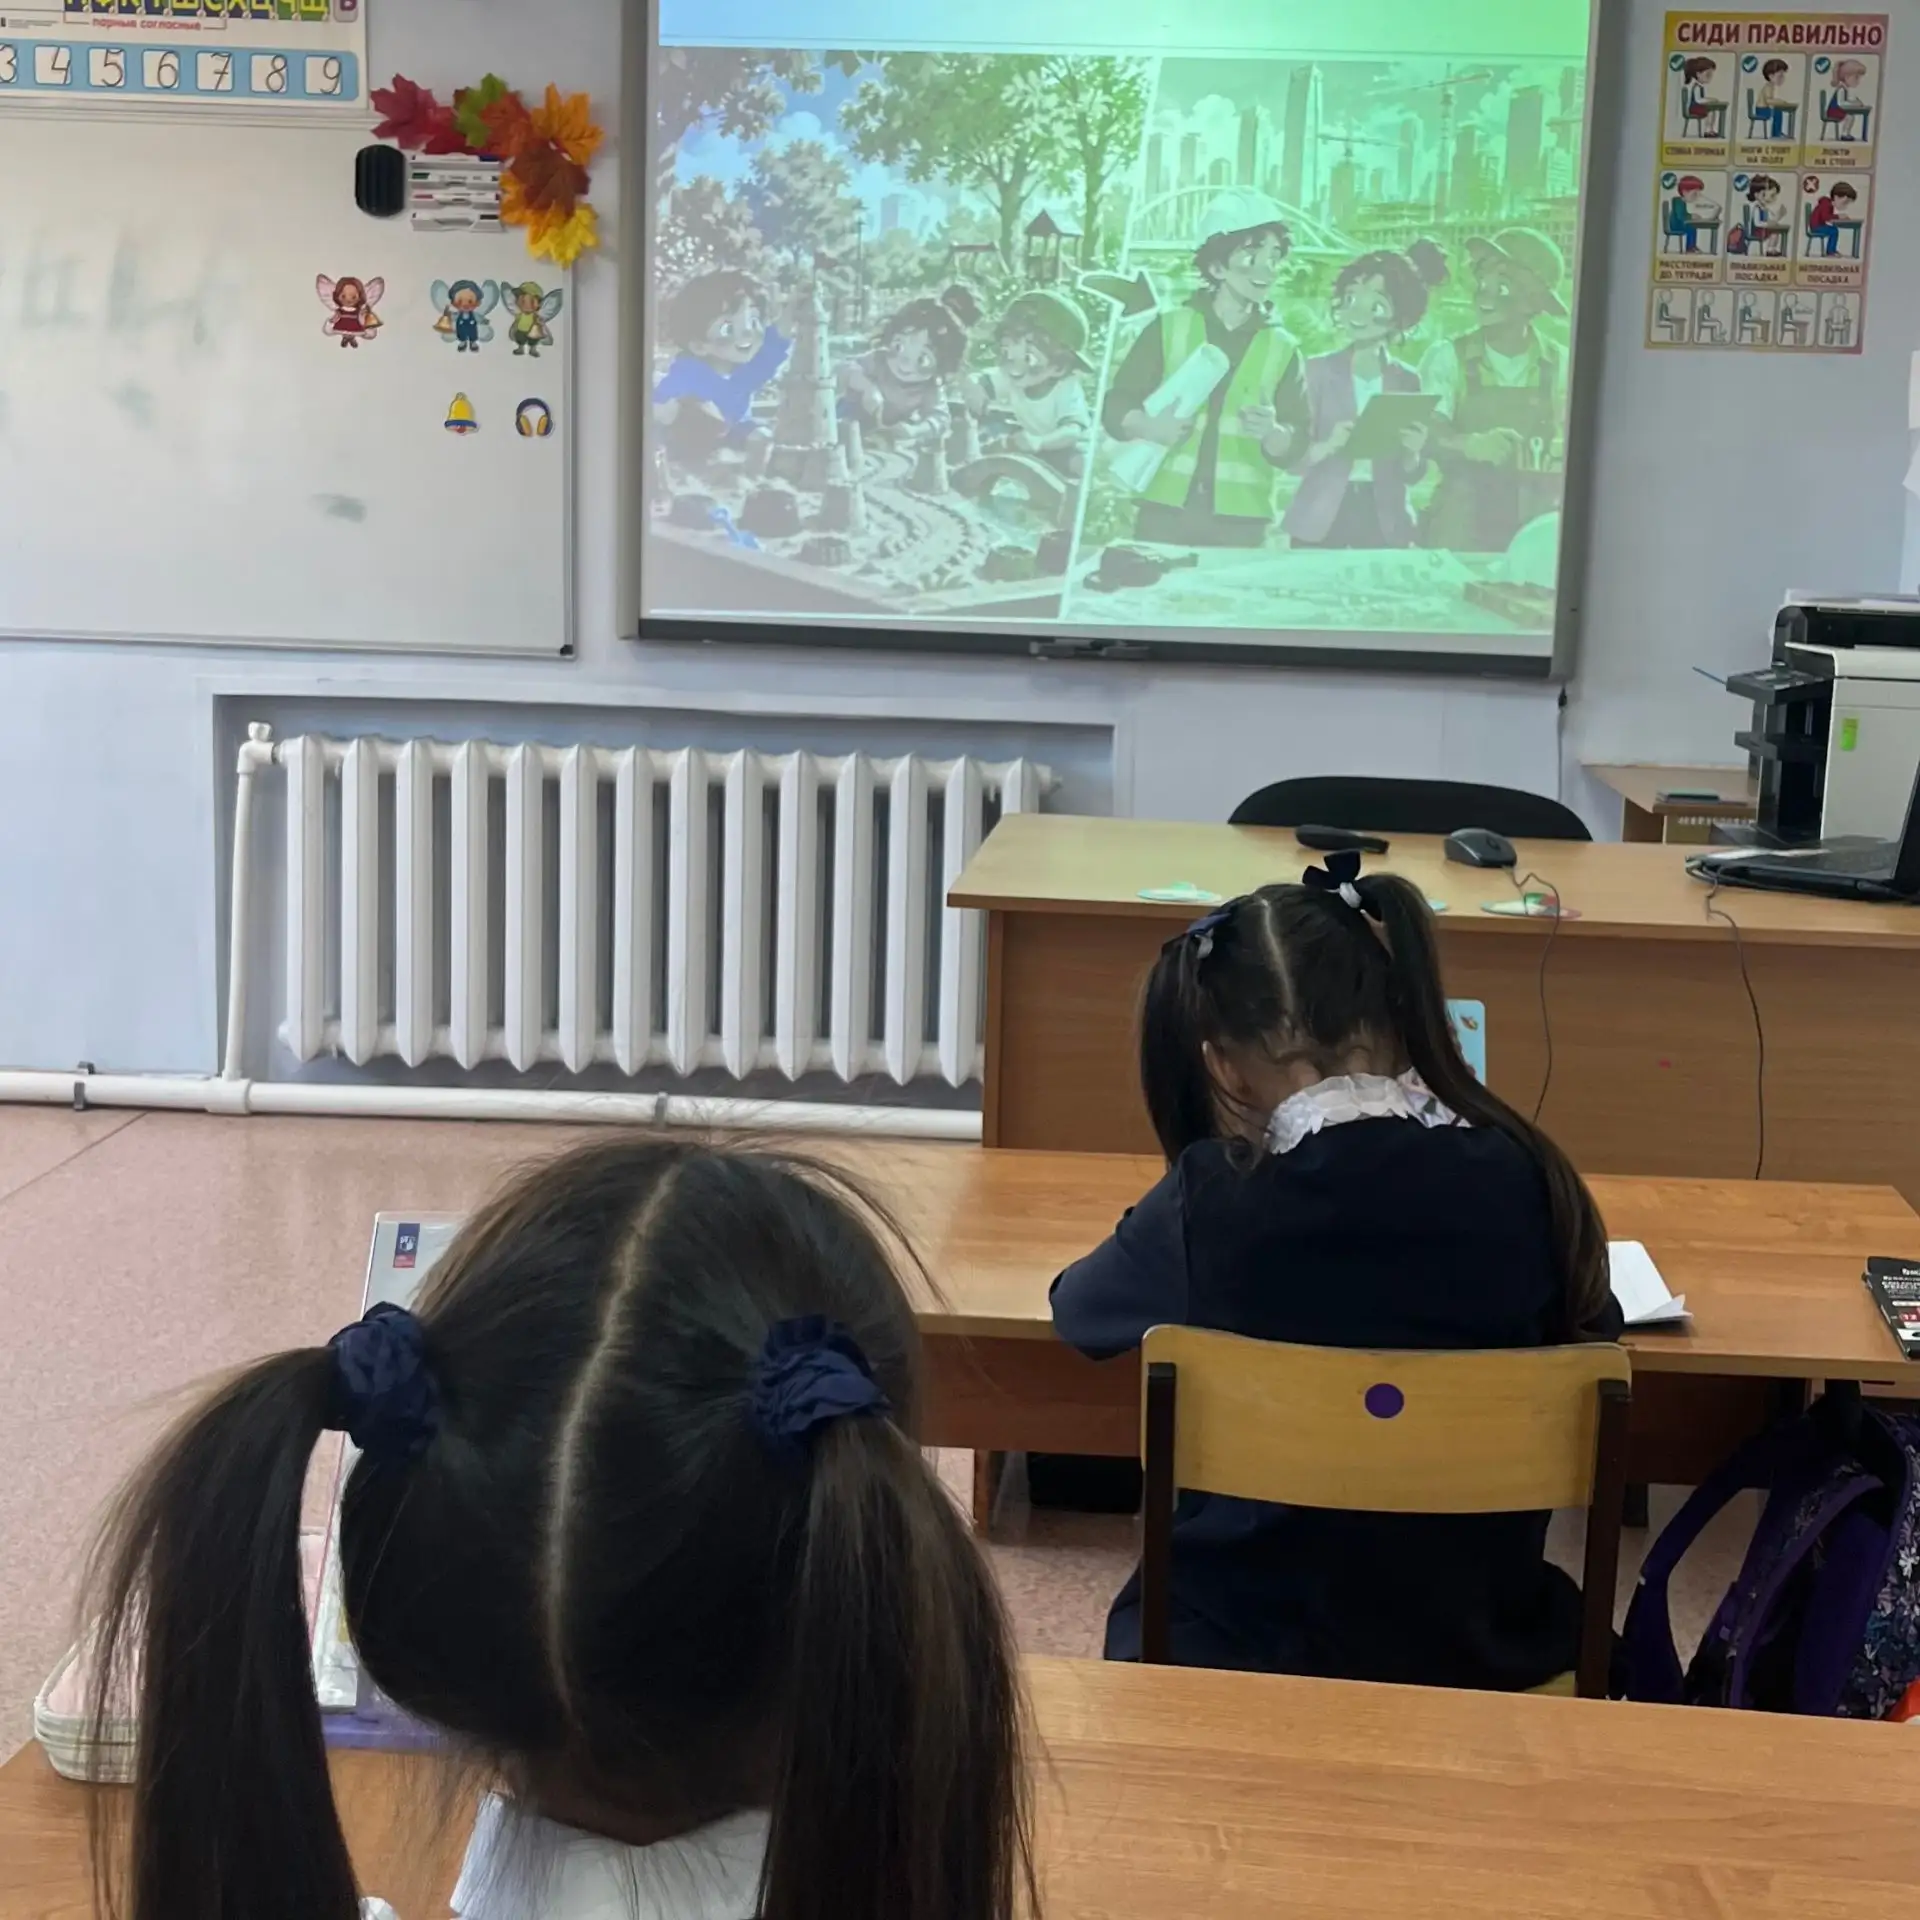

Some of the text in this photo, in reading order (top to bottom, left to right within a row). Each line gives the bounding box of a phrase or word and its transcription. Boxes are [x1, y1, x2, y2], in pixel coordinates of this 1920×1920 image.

[1677, 22, 1882, 46] СИДИ ПРАВИЛЬНО
[51, 46, 71, 85] 4
[102, 48, 124, 87] 5
[157, 50, 180, 89] 6
[211, 52, 232, 92] 7
[265, 54, 287, 93] 8
[320, 56, 342, 95] 9
